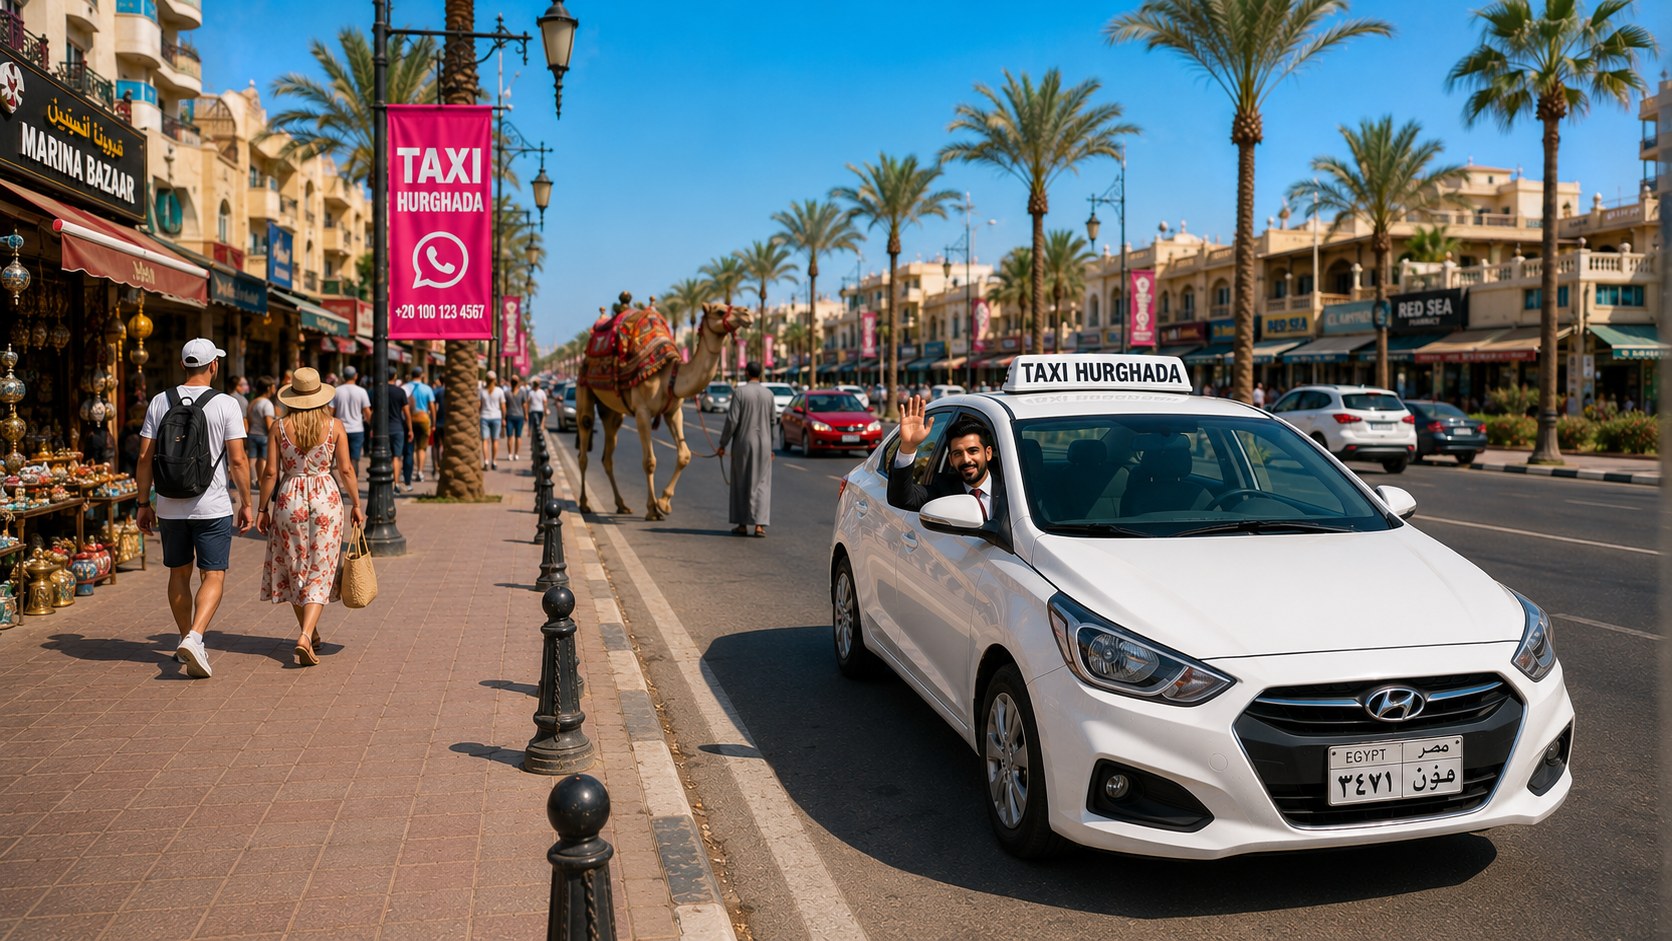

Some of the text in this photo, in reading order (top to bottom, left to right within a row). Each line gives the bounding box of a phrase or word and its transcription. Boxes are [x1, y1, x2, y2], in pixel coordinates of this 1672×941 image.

[21, 121, 135, 204] MARINA BAZAAR
[397, 147, 482, 184] TAXI
[397, 191, 484, 213] HURGHADA
[395, 304, 485, 319] +20 100 123 4567
[1398, 301, 1424, 319] RED
[1426, 298, 1453, 317] SEA
[1021, 362, 1183, 384] TAXI HURGHADA
[1345, 748, 1387, 764] EGYPT
[1418, 743, 1449, 759] مصر
[1338, 770, 1393, 798] ٣٤٧١
